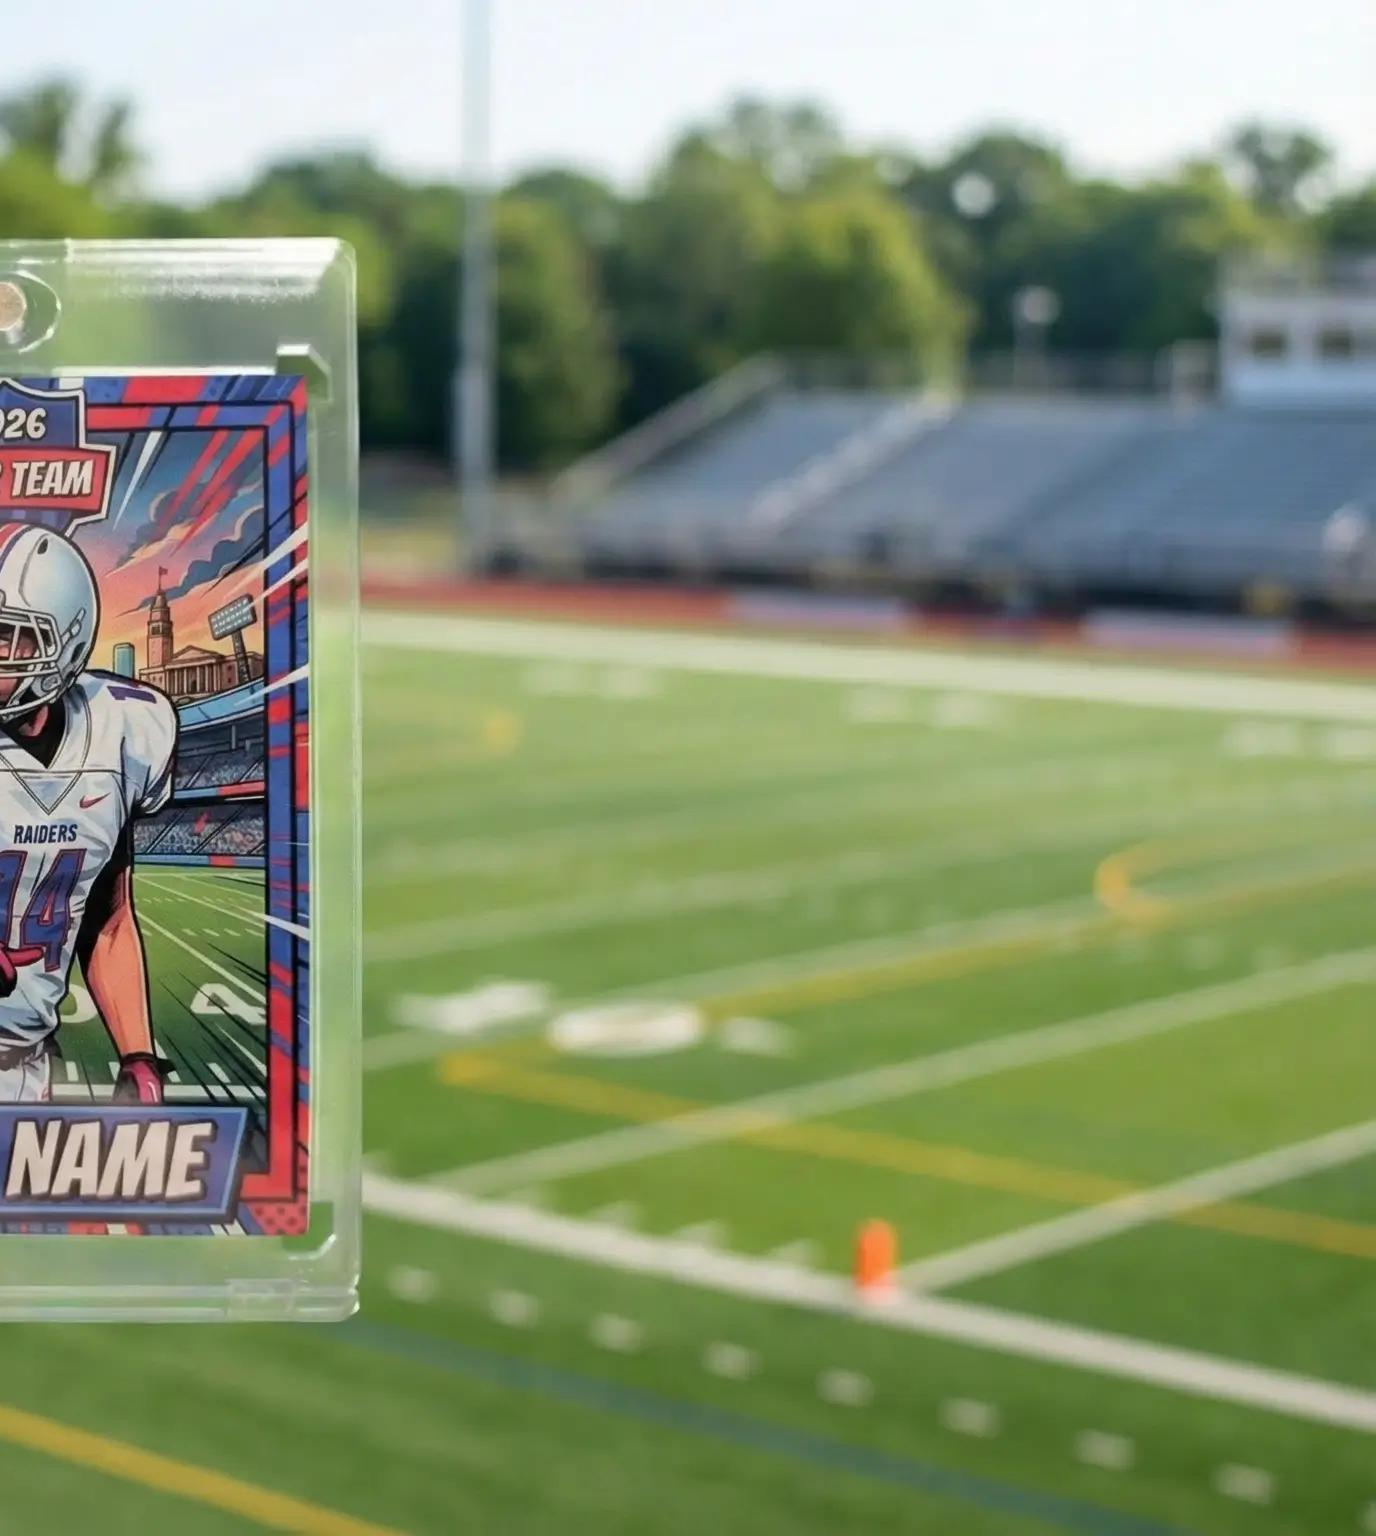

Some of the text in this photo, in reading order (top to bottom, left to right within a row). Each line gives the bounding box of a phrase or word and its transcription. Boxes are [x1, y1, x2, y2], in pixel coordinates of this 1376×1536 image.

[12, 459, 95, 497] TEAM
[13, 824, 78, 844] RAIDERS
[4, 1119, 218, 1200] NAME
